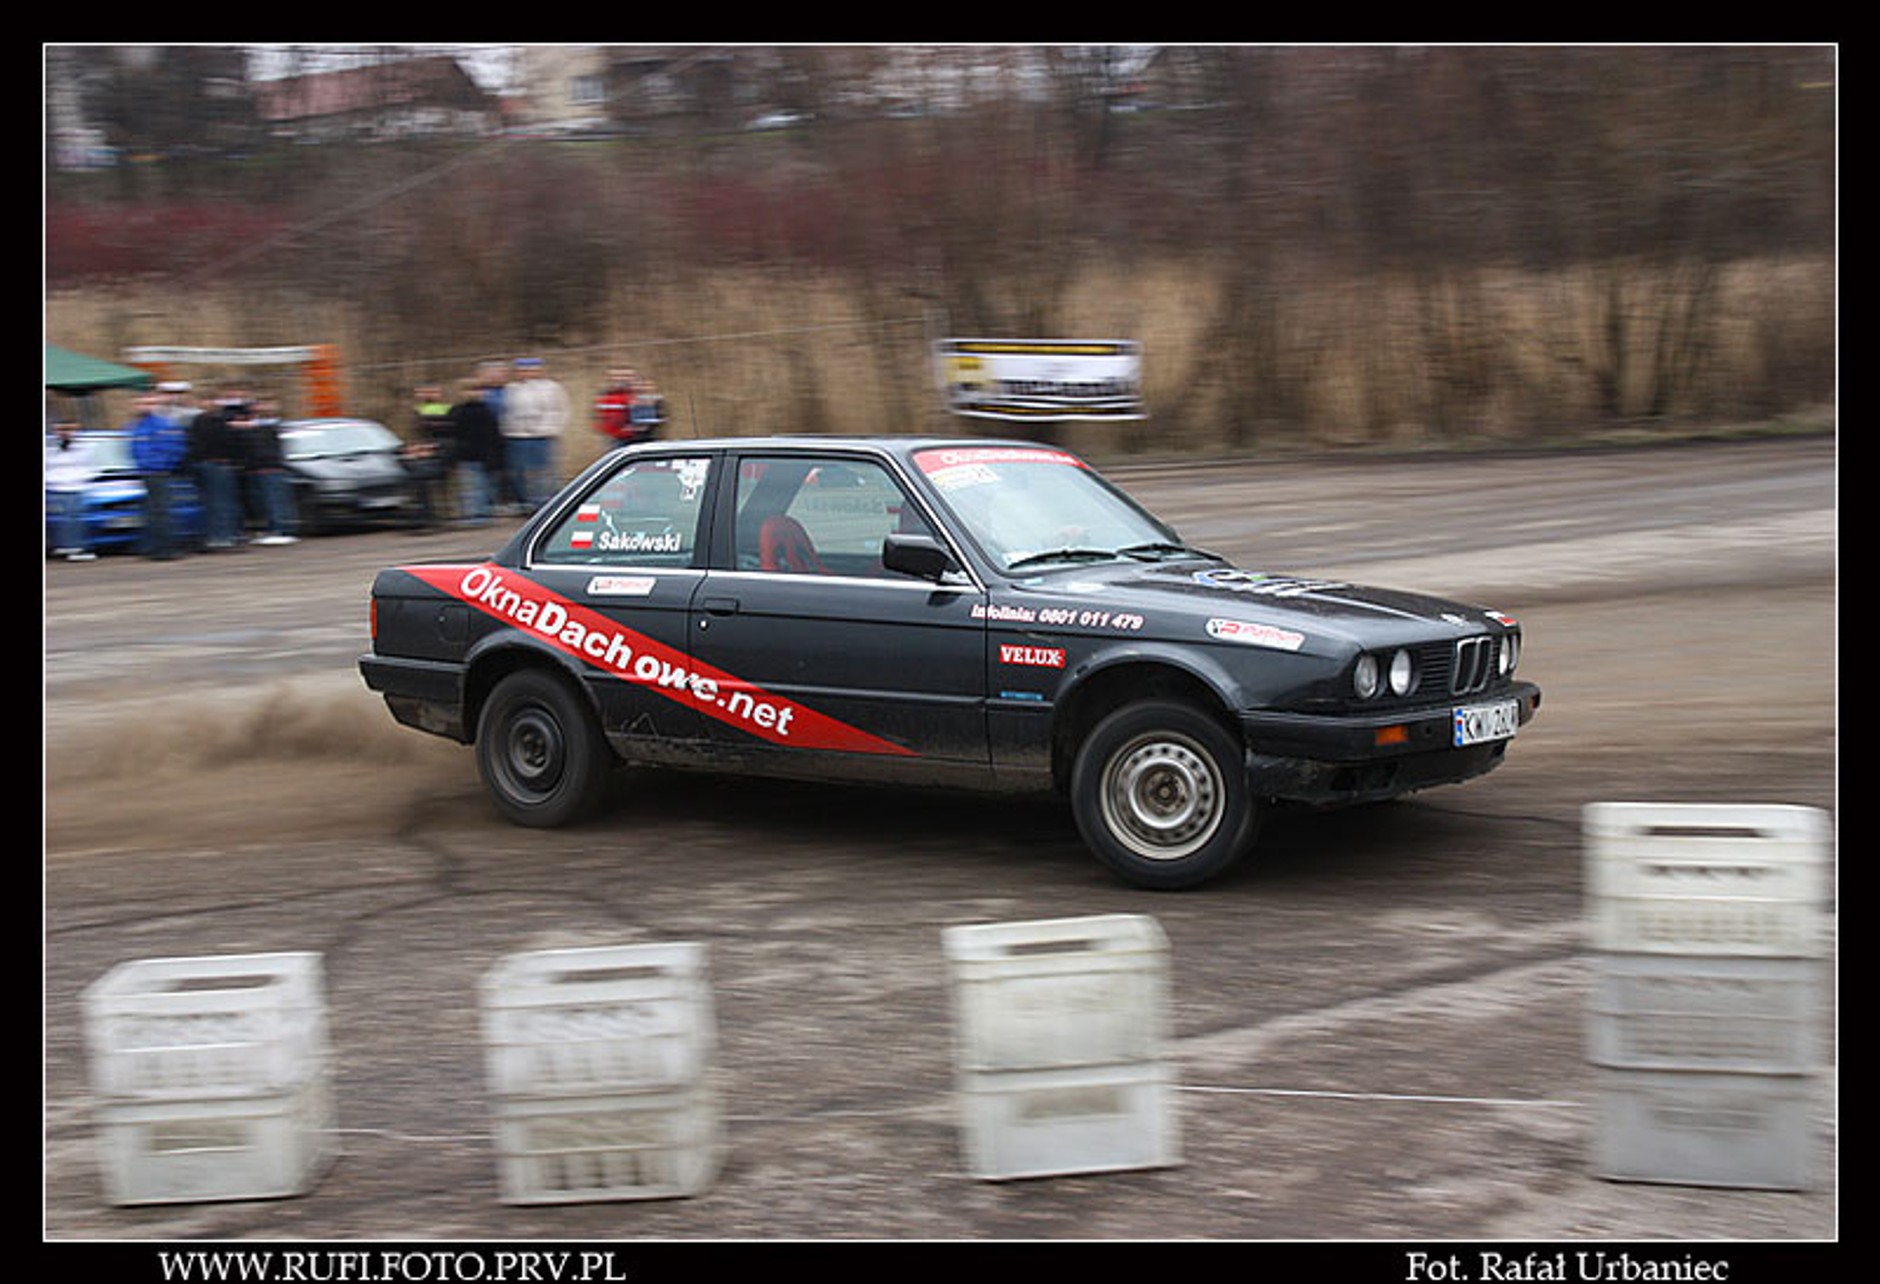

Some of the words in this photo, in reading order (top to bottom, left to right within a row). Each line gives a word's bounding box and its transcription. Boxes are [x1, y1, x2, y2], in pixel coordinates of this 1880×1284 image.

[598, 531, 682, 551] Sakowski
[1080, 610, 1110, 627] 011
[1000, 645, 1062, 666] VELUX
